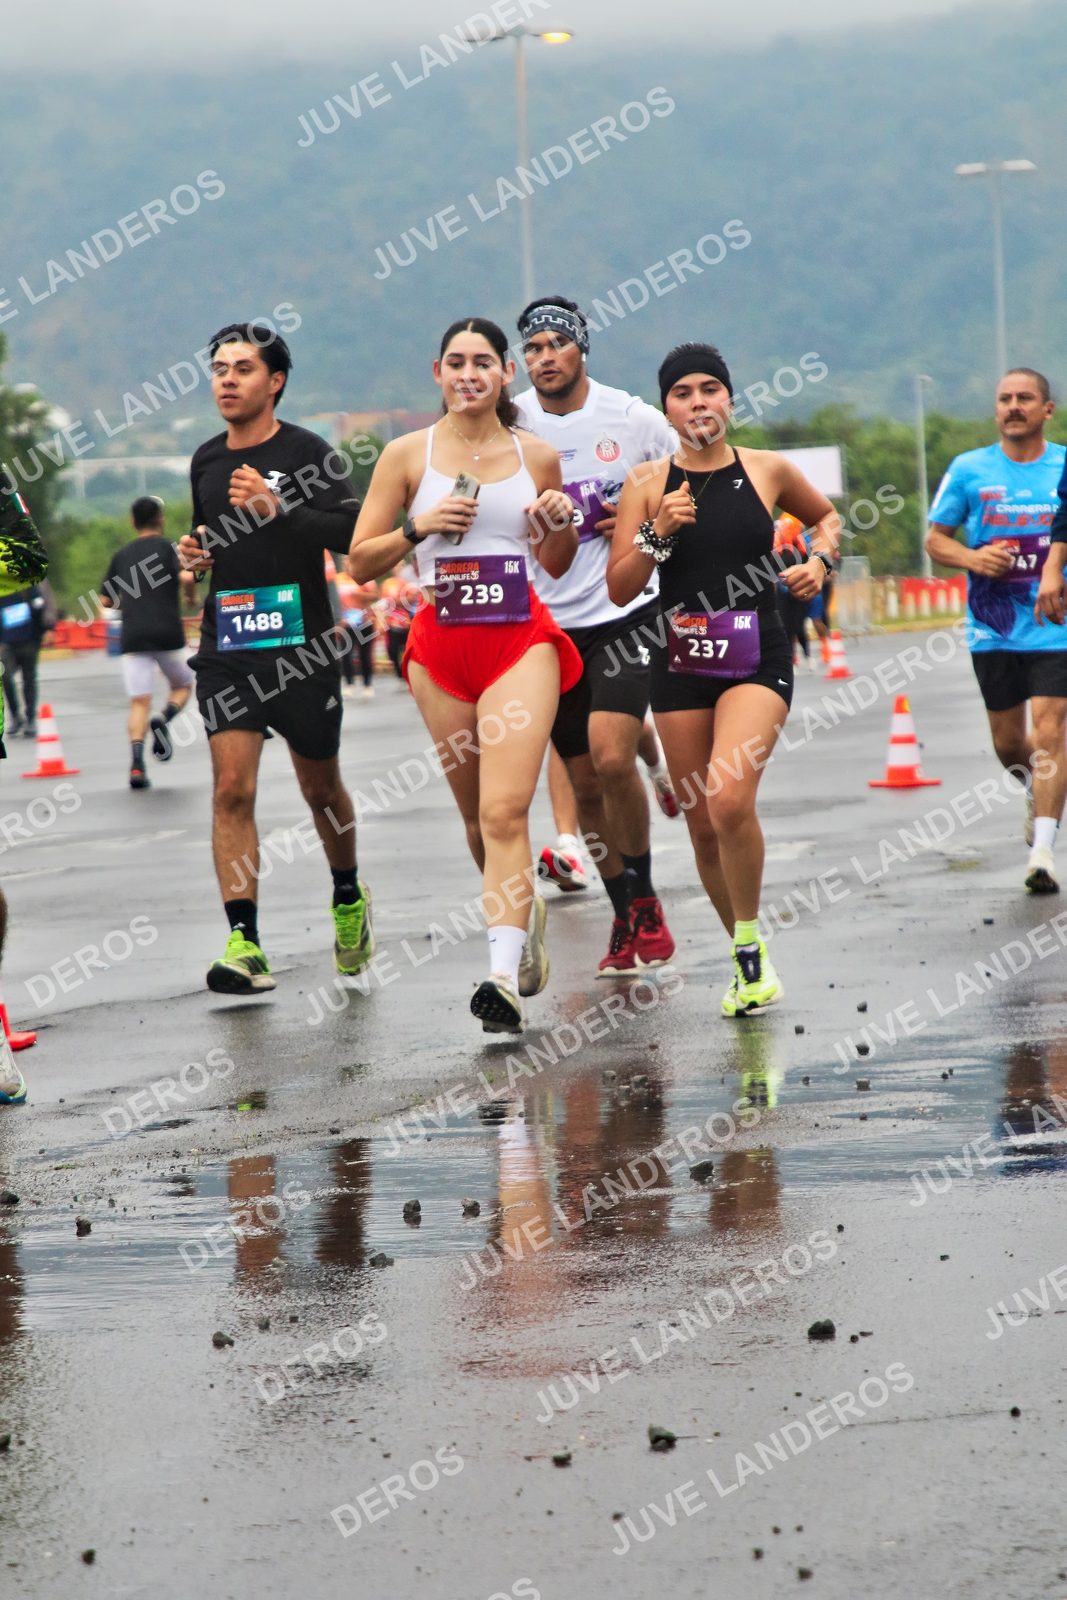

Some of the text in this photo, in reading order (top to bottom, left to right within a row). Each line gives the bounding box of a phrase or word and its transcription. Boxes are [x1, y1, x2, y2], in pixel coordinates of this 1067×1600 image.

[580, 482, 597, 496] 15K
[440, 562, 480, 574] CARRERA
[504, 560, 520, 574] 15K
[440, 573, 471, 582] OMNILIFE
[277, 589, 294, 602] 10K
[460, 583, 504, 605] 239
[231, 612, 284, 633] 1488
[733, 615, 752, 630] 15K
[687, 638, 729, 659] 237
